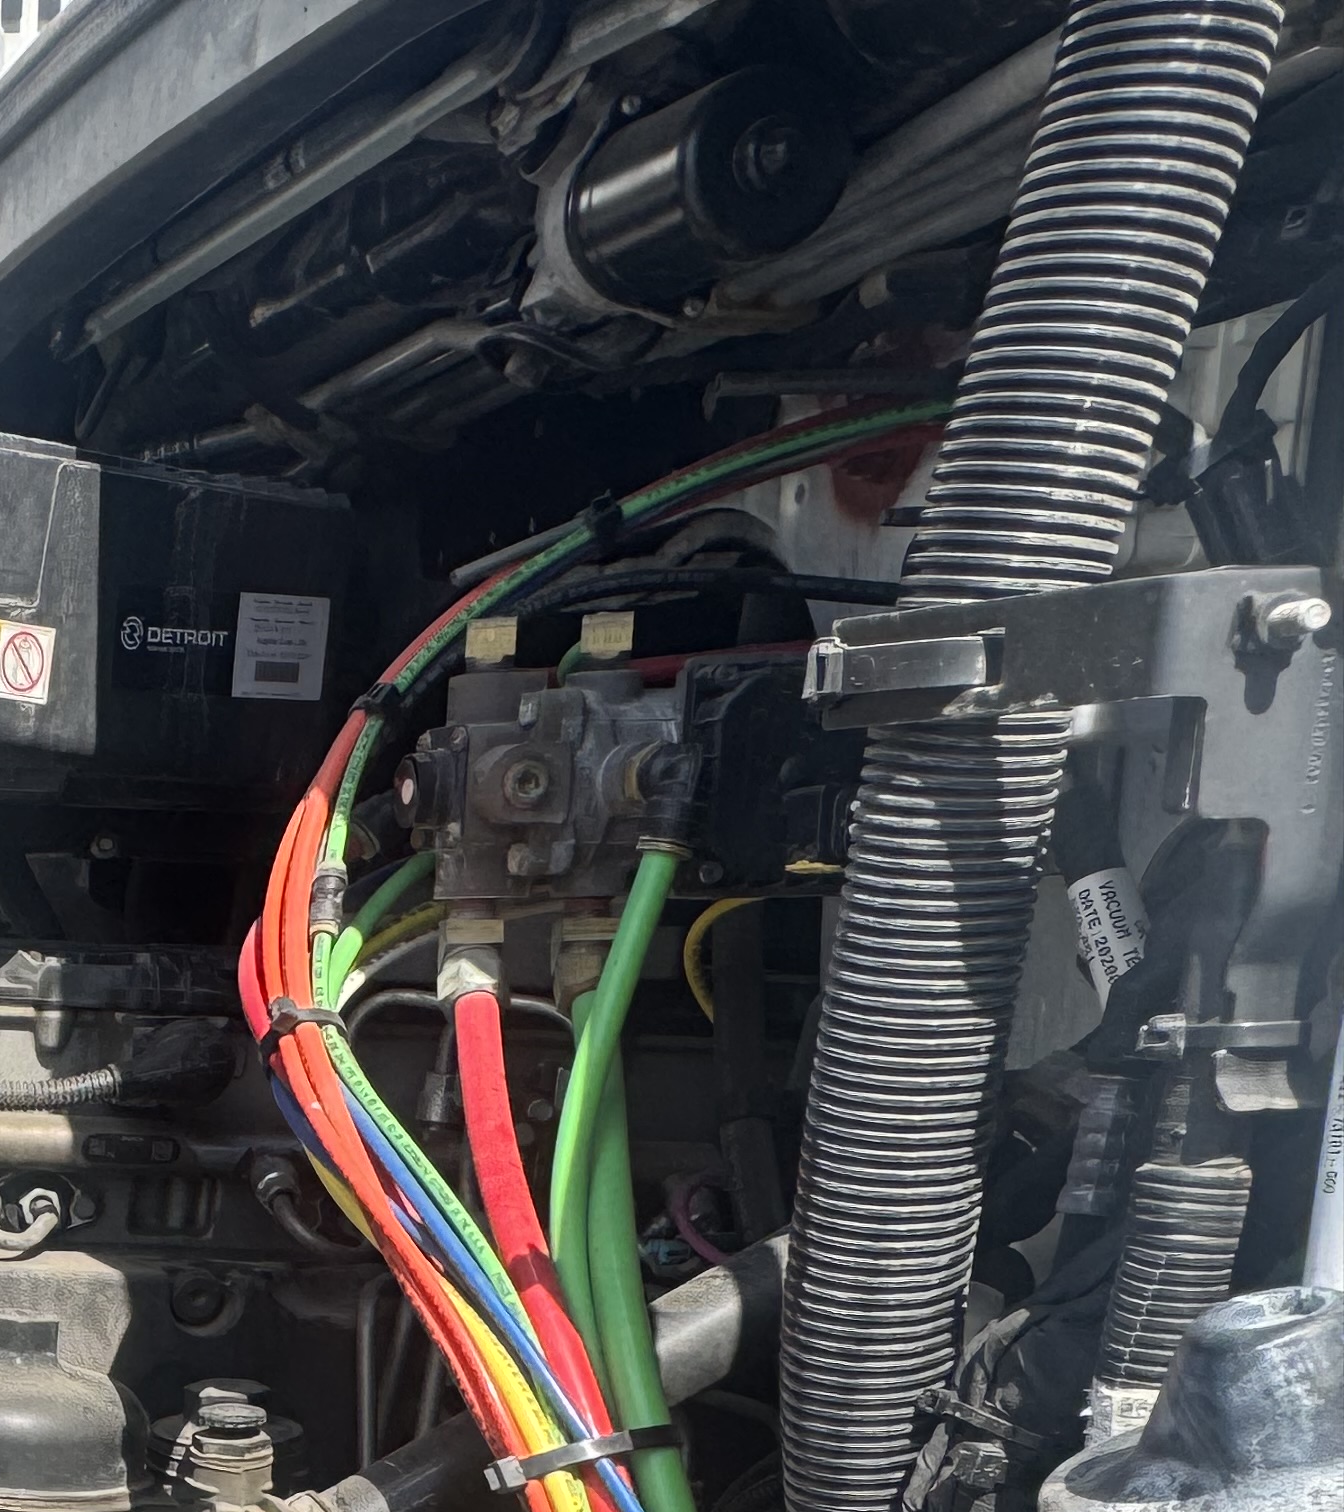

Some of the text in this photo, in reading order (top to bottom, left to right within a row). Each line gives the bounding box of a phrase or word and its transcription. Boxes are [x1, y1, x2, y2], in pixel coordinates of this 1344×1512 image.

[147, 626, 228, 647] DETROIT
[1098, 880, 1132, 940] VACUUM
[1122, 946, 1143, 968] TE
